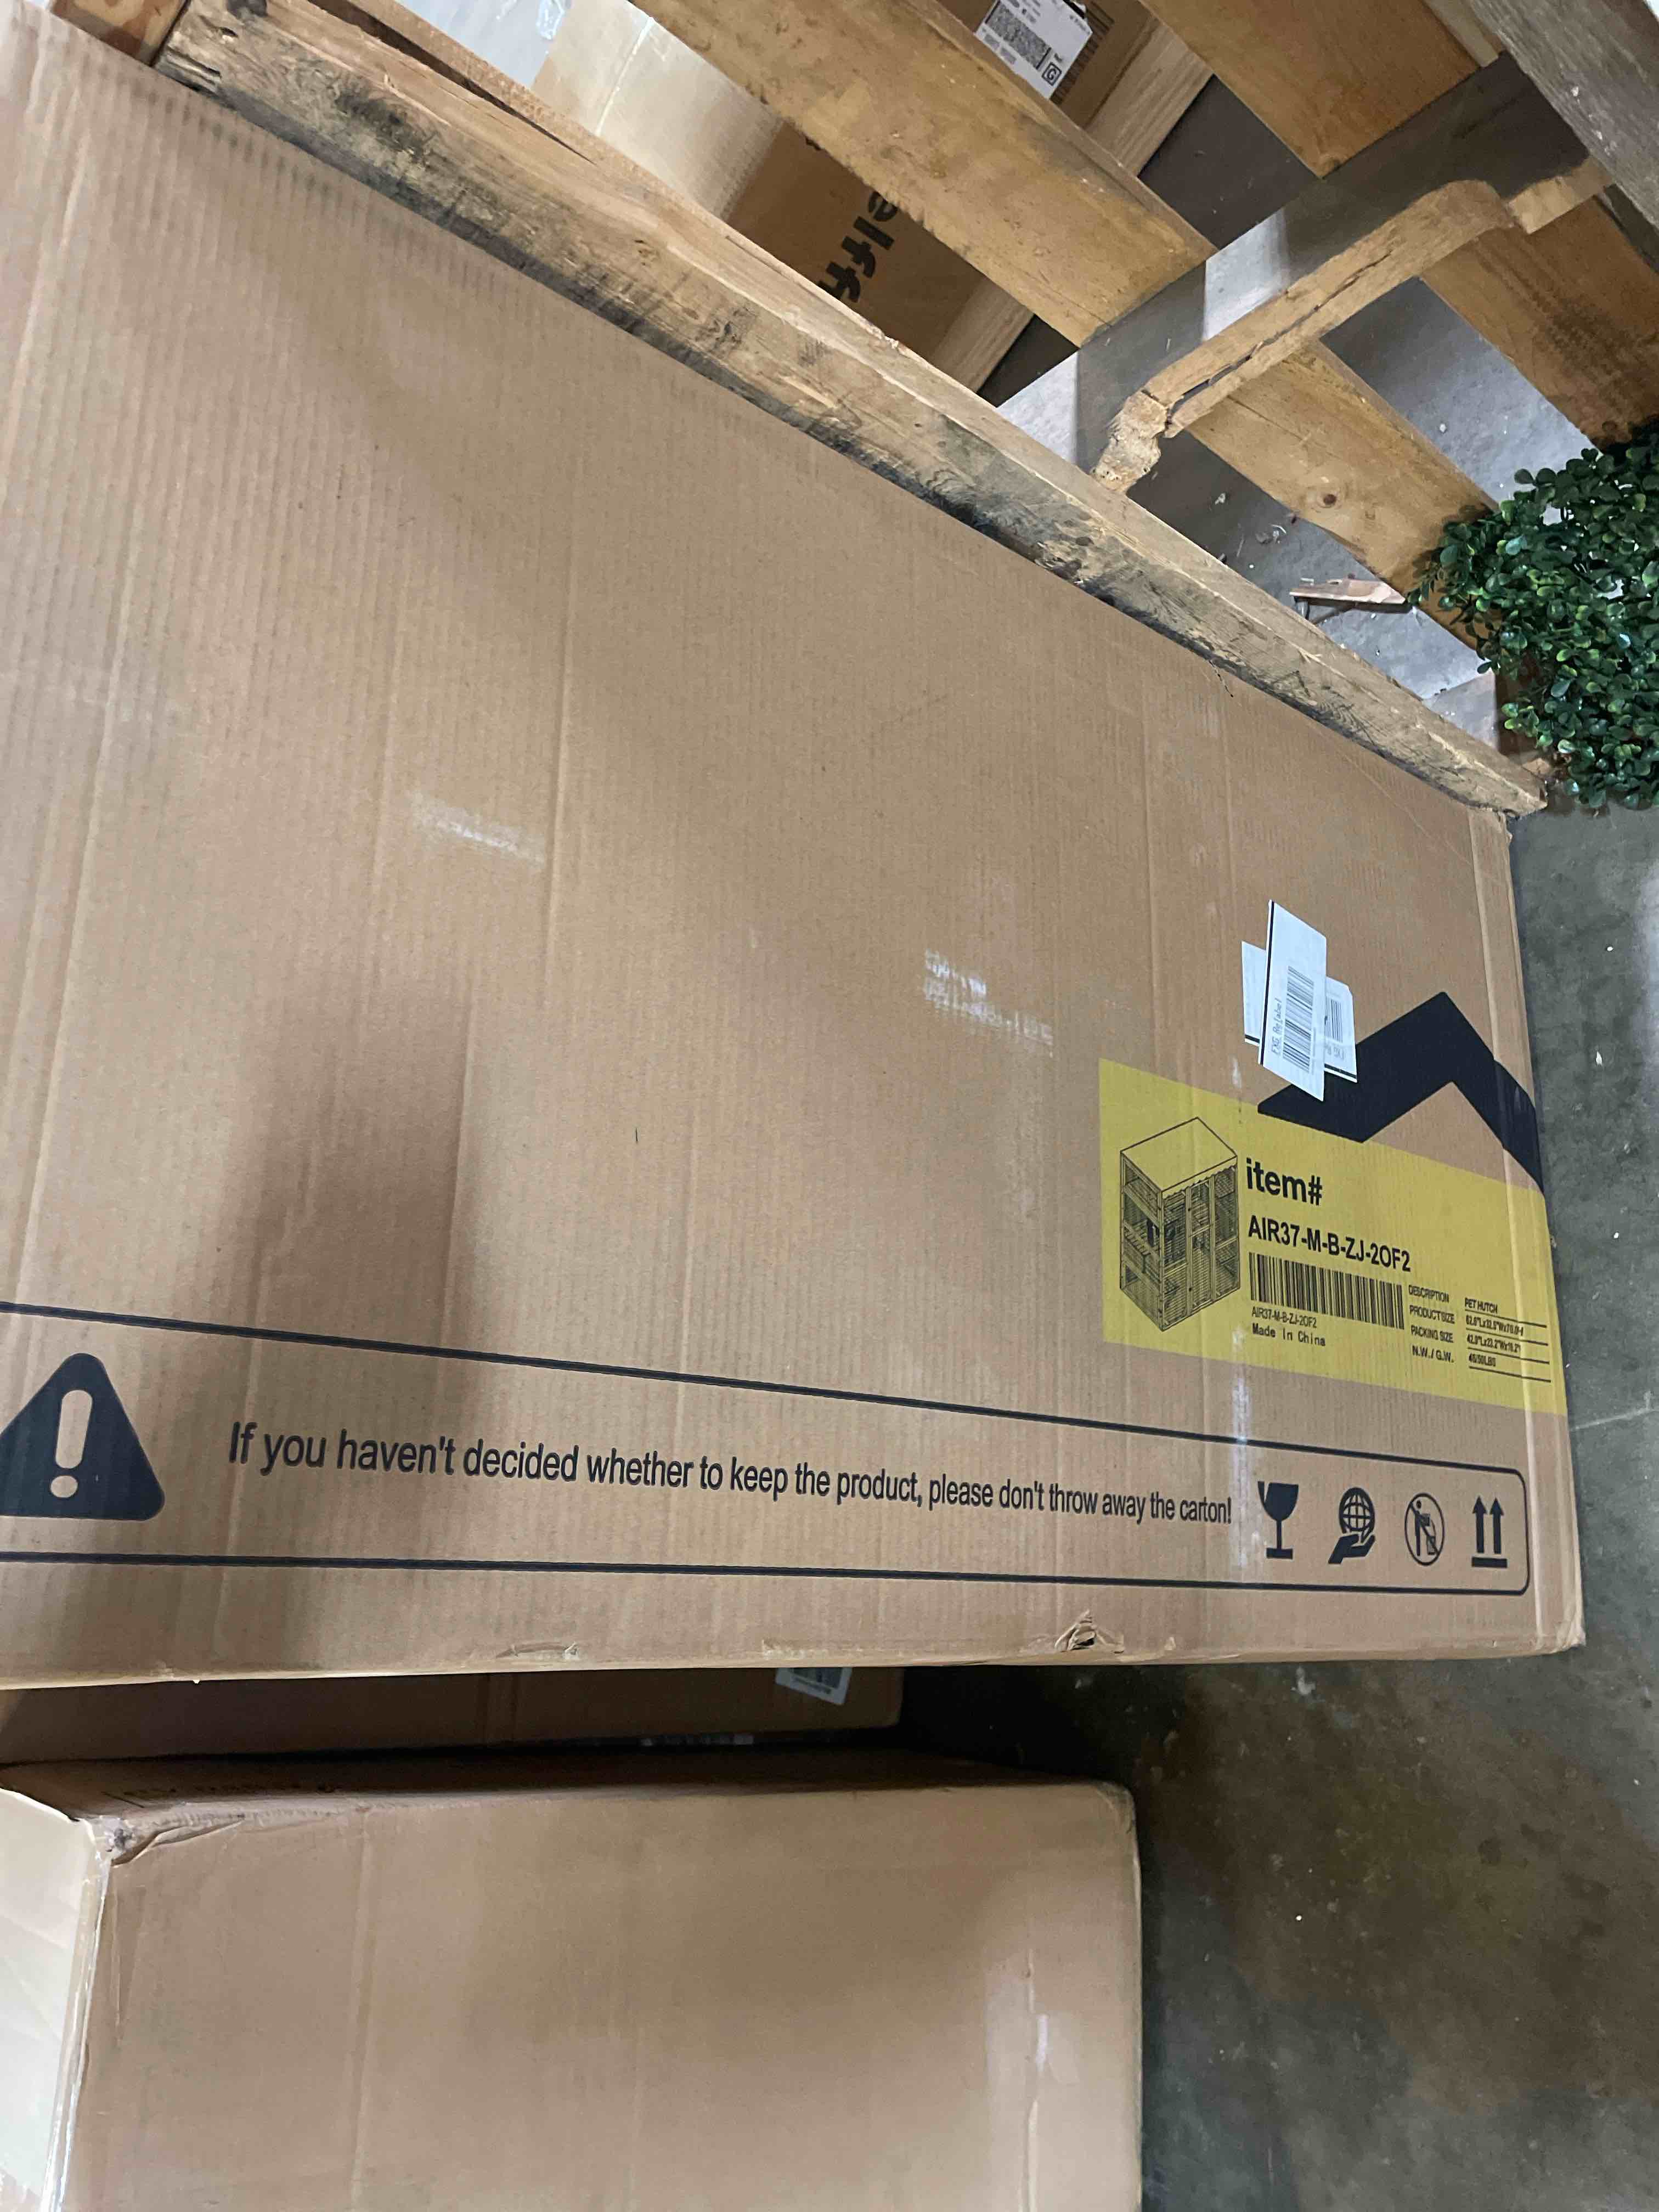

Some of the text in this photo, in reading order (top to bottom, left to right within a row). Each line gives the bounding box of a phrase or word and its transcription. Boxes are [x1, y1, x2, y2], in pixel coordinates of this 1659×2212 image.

[1272, 998, 1283, 1035] Relabel
[1246, 1157, 1323, 1206] item#
[1408, 1284, 1449, 1304] DESCRIPTION
[1409, 1304, 1455, 1324] PRODUCT SIZE
[1464, 1297, 1498, 1314] PET HUTCH
[1252, 1323, 1276, 1338] Made
[1298, 1330, 1326, 1346] China
[1410, 1324, 1454, 1344] PACKING SIZE
[1436, 1350, 1455, 1363] G.W.
[229, 1422, 1232, 1525] If you haven't decided whether to keep the product, please don't throw away the carton!
